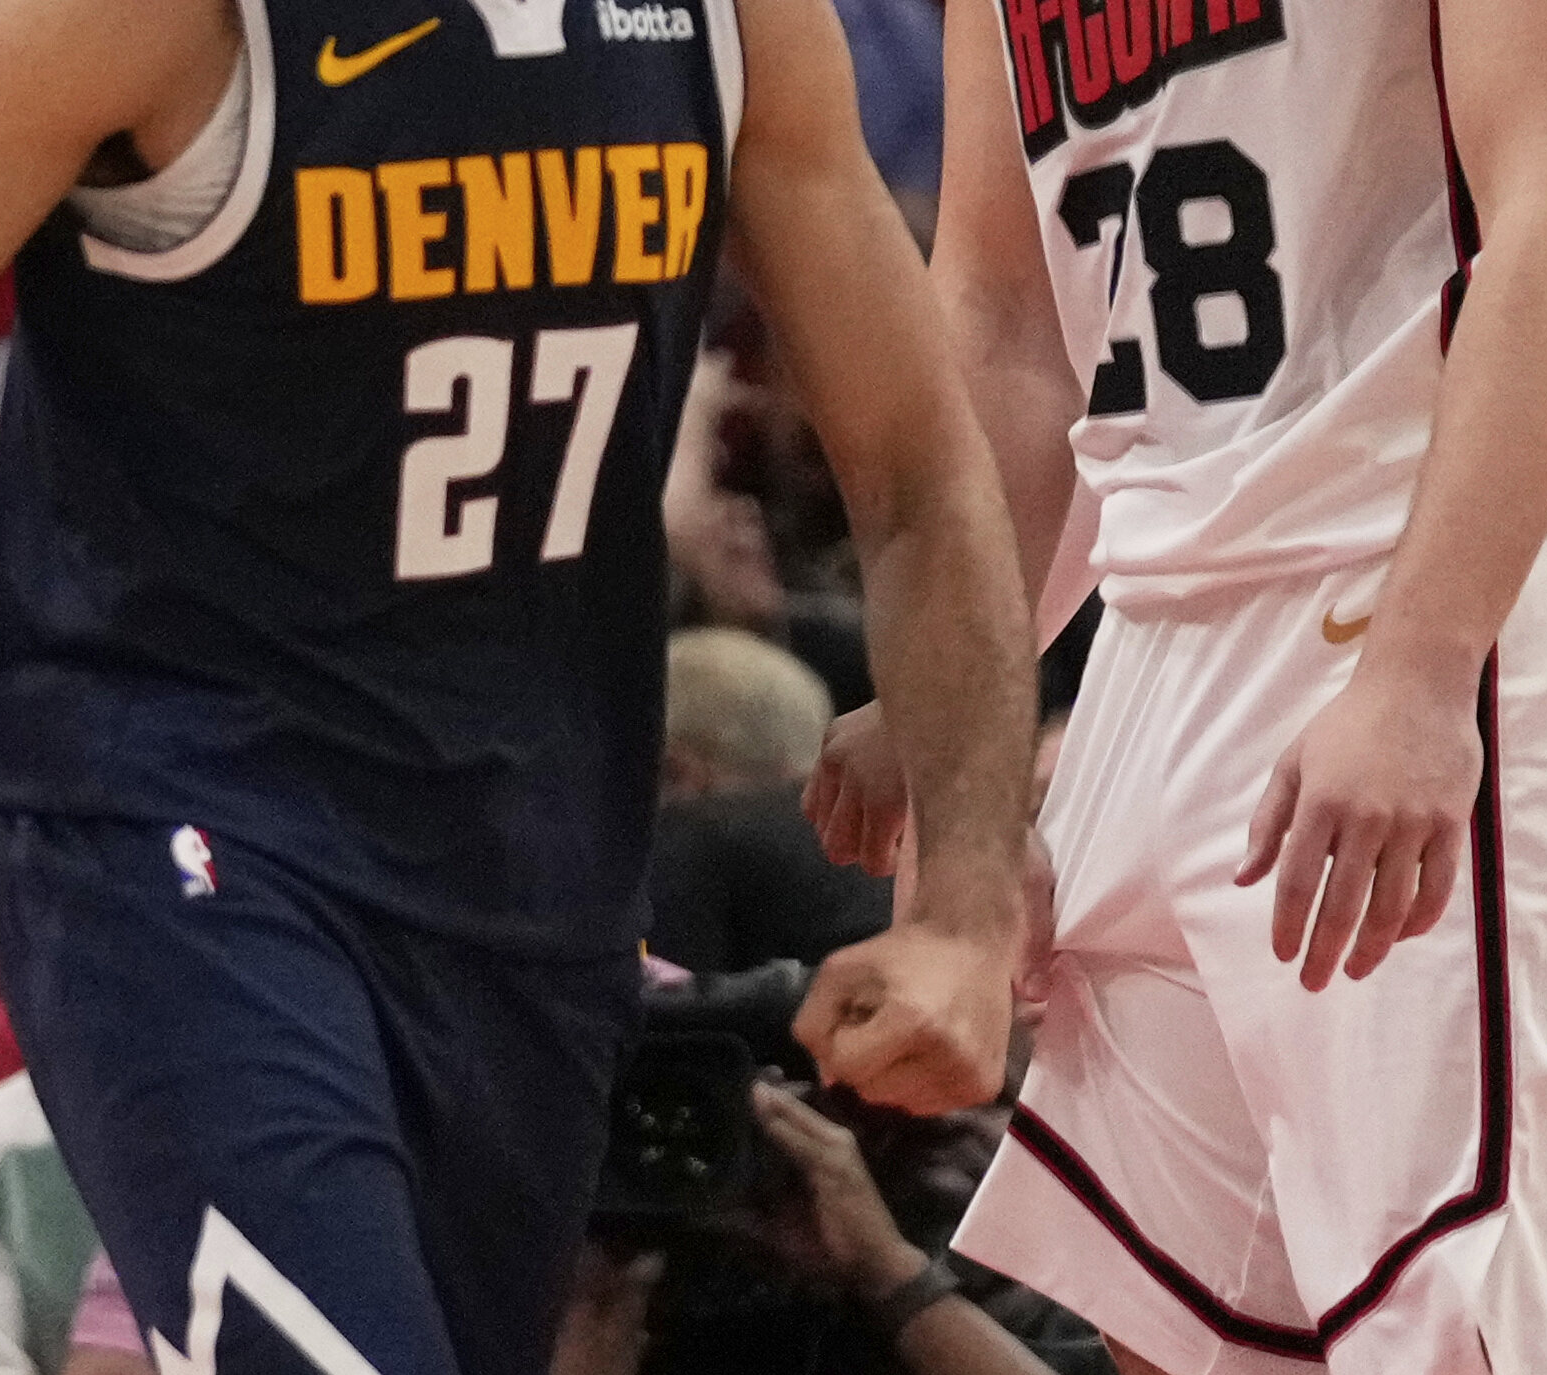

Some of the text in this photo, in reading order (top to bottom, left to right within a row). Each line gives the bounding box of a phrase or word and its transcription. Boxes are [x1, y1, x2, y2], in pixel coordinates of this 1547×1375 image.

[295, 142, 708, 305] DENVER
[1058, 138, 1287, 417] 28
[395, 323, 640, 581] 27
